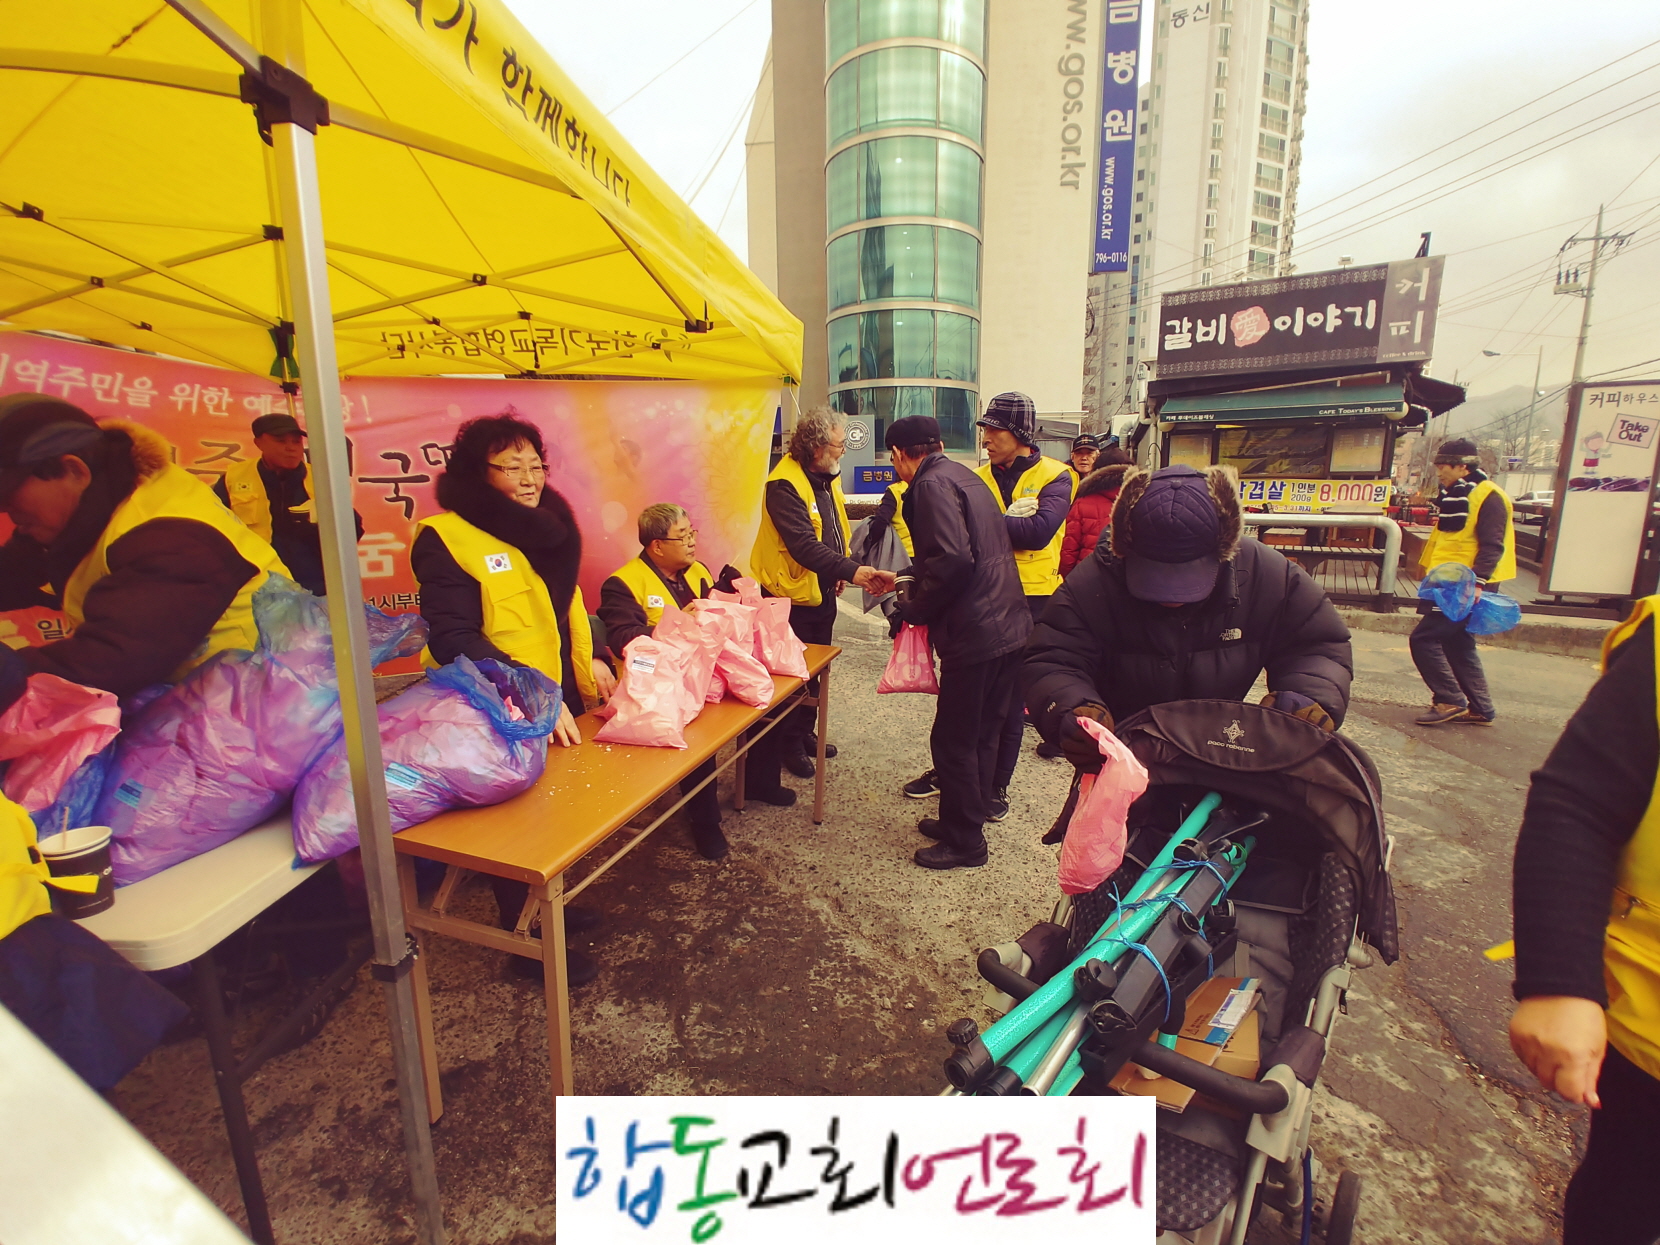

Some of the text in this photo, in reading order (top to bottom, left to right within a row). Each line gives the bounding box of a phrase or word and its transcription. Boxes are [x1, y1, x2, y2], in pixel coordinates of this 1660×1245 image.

[1170, 2, 1210, 28] 동신
[1101, 156, 1116, 240] www.gos.or.kr
[1095, 252, 1128, 264] 796-0116
[1164, 313, 1228, 351] 갈비
[1273, 299, 1377, 337] 이야기
[168, 382, 234, 416] 위한
[1618, 429, 1643, 443] Out
[1620, 419, 1650, 433] Take
[1290, 493, 1312, 502] 200g
